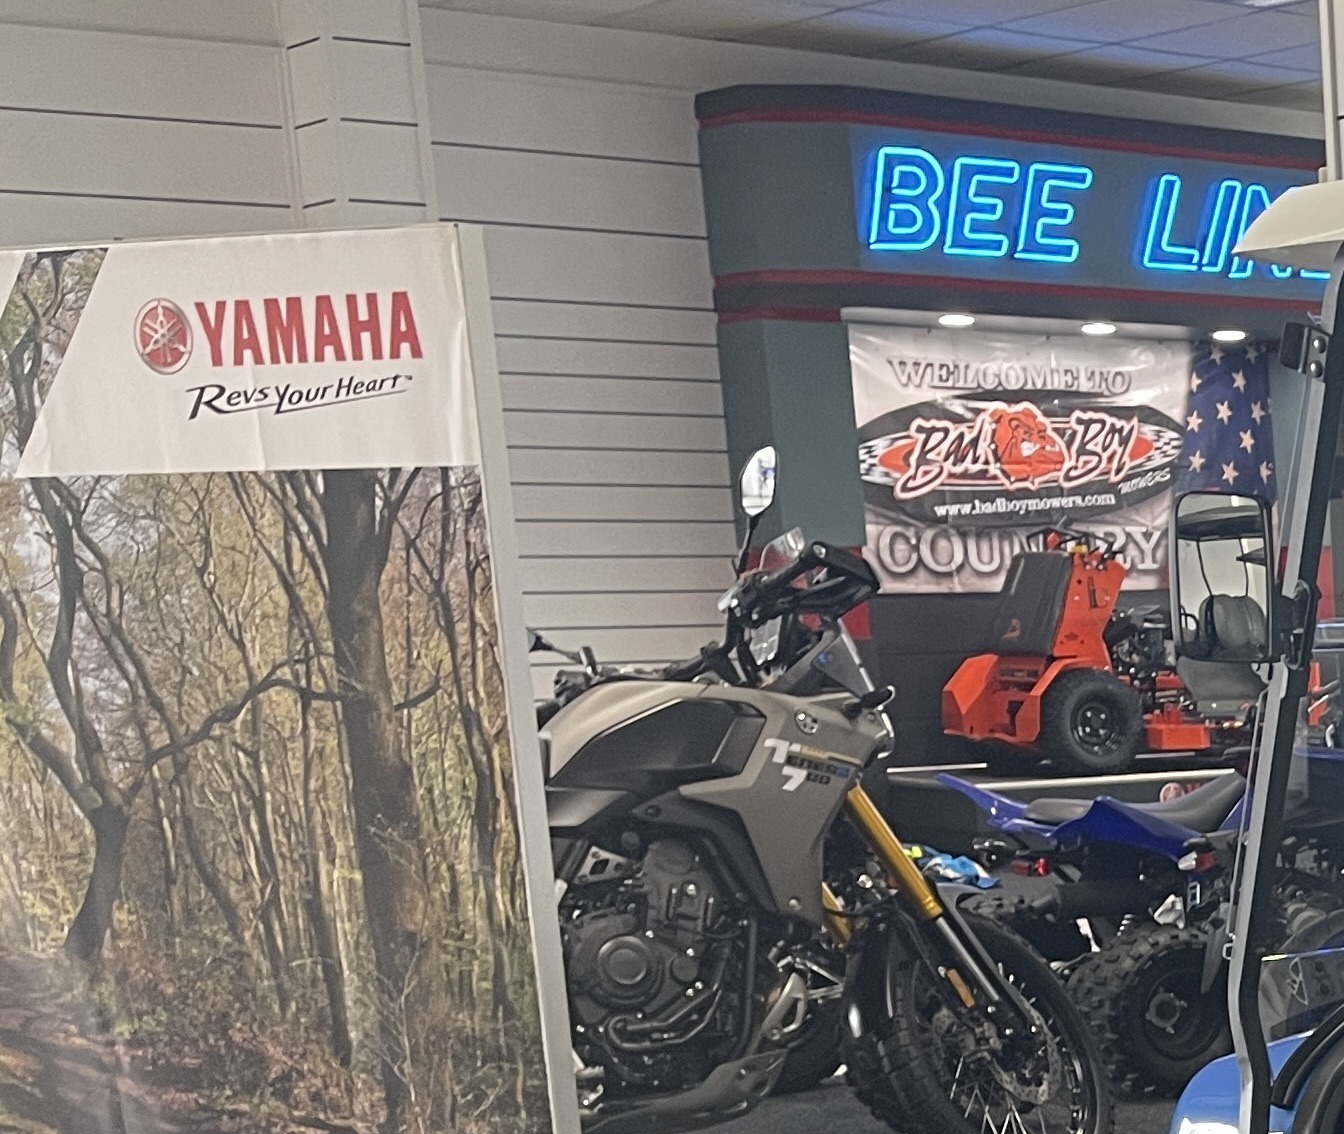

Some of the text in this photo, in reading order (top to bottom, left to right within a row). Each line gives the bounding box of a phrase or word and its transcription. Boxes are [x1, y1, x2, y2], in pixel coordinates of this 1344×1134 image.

[869, 146, 1331, 279] BEE LIN
[193, 290, 424, 367] YAMAHA
[185, 374, 402, 421] Revs Your Heart
[888, 359, 1131, 394] WELCOME TO
[895, 410, 1138, 499] Bad Boy
[934, 492, 1116, 517] www.badboymowers.com
[879, 525, 1165, 574] COUNRY
